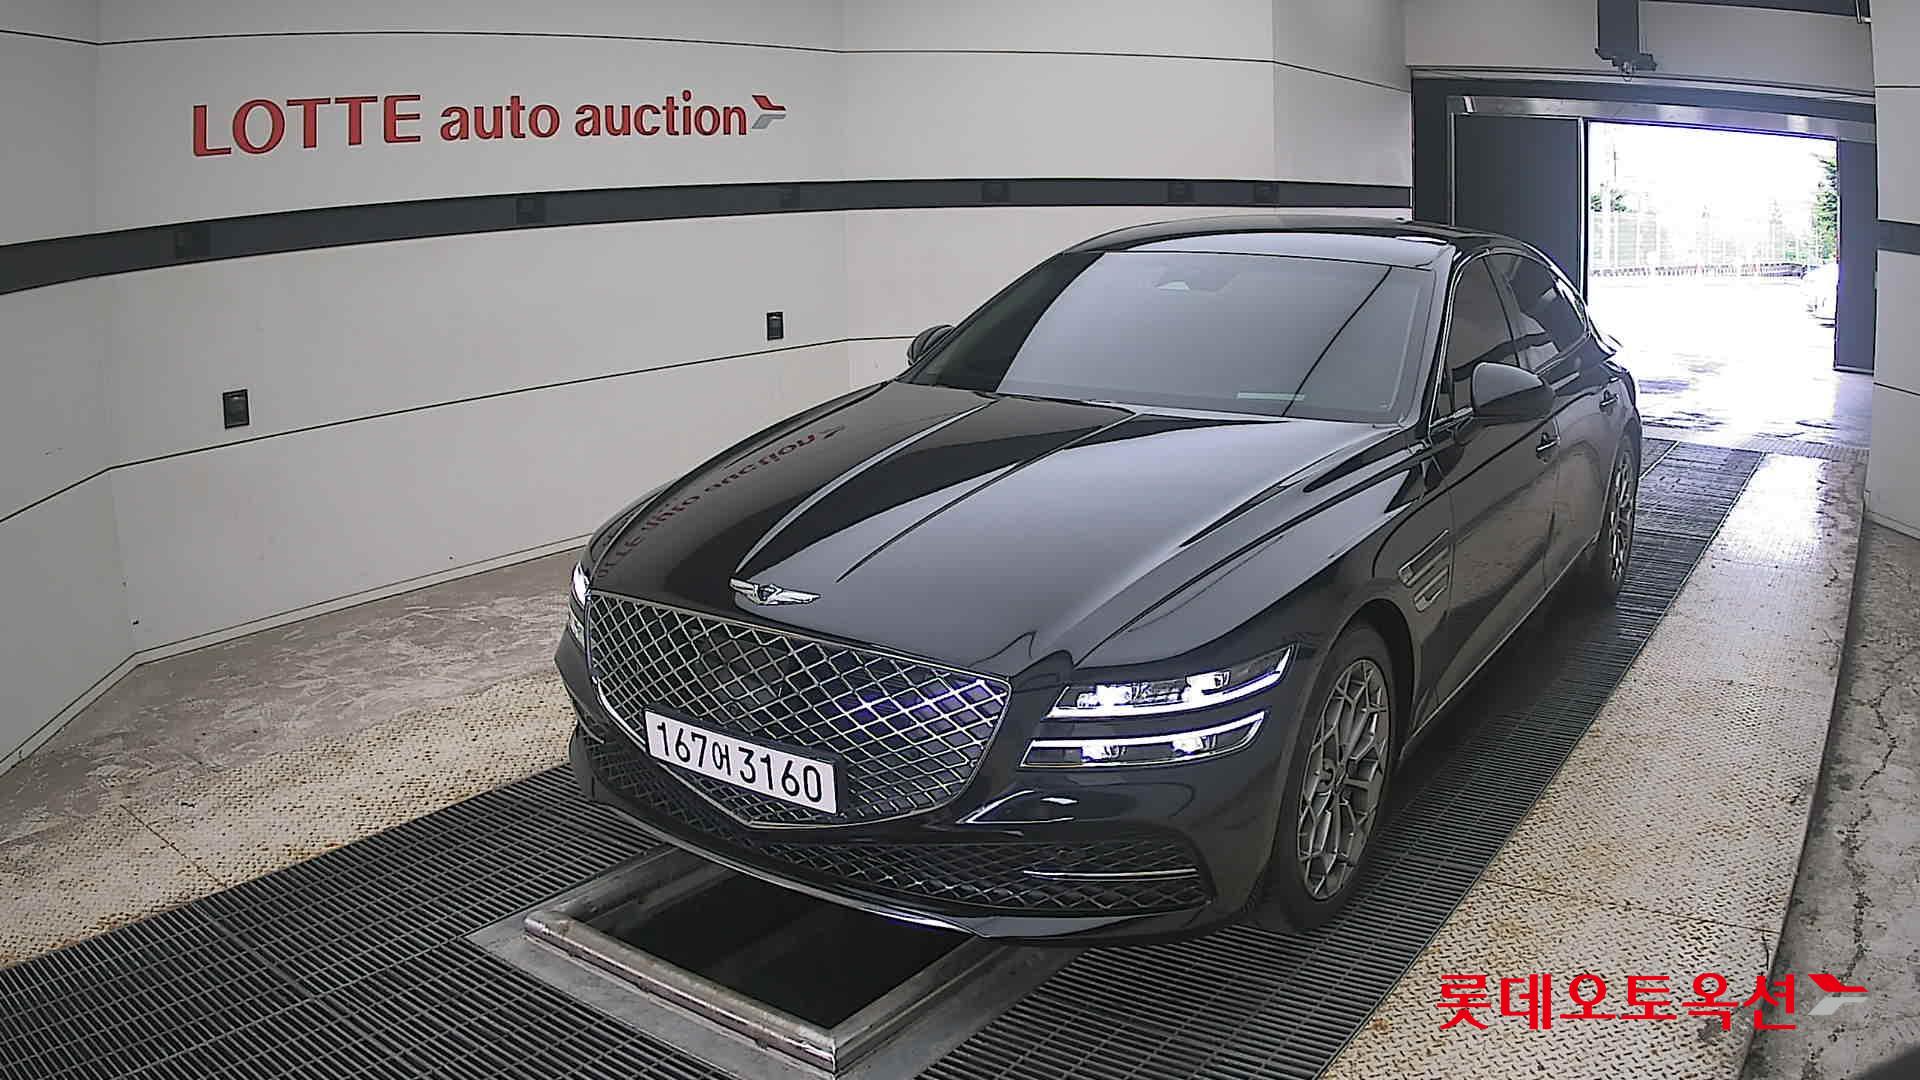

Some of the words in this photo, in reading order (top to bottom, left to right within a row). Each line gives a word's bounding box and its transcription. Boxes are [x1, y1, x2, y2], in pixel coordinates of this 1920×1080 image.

[192, 95, 422, 158] LOTTE
[439, 95, 561, 141] auto
[575, 89, 749, 138] auction
